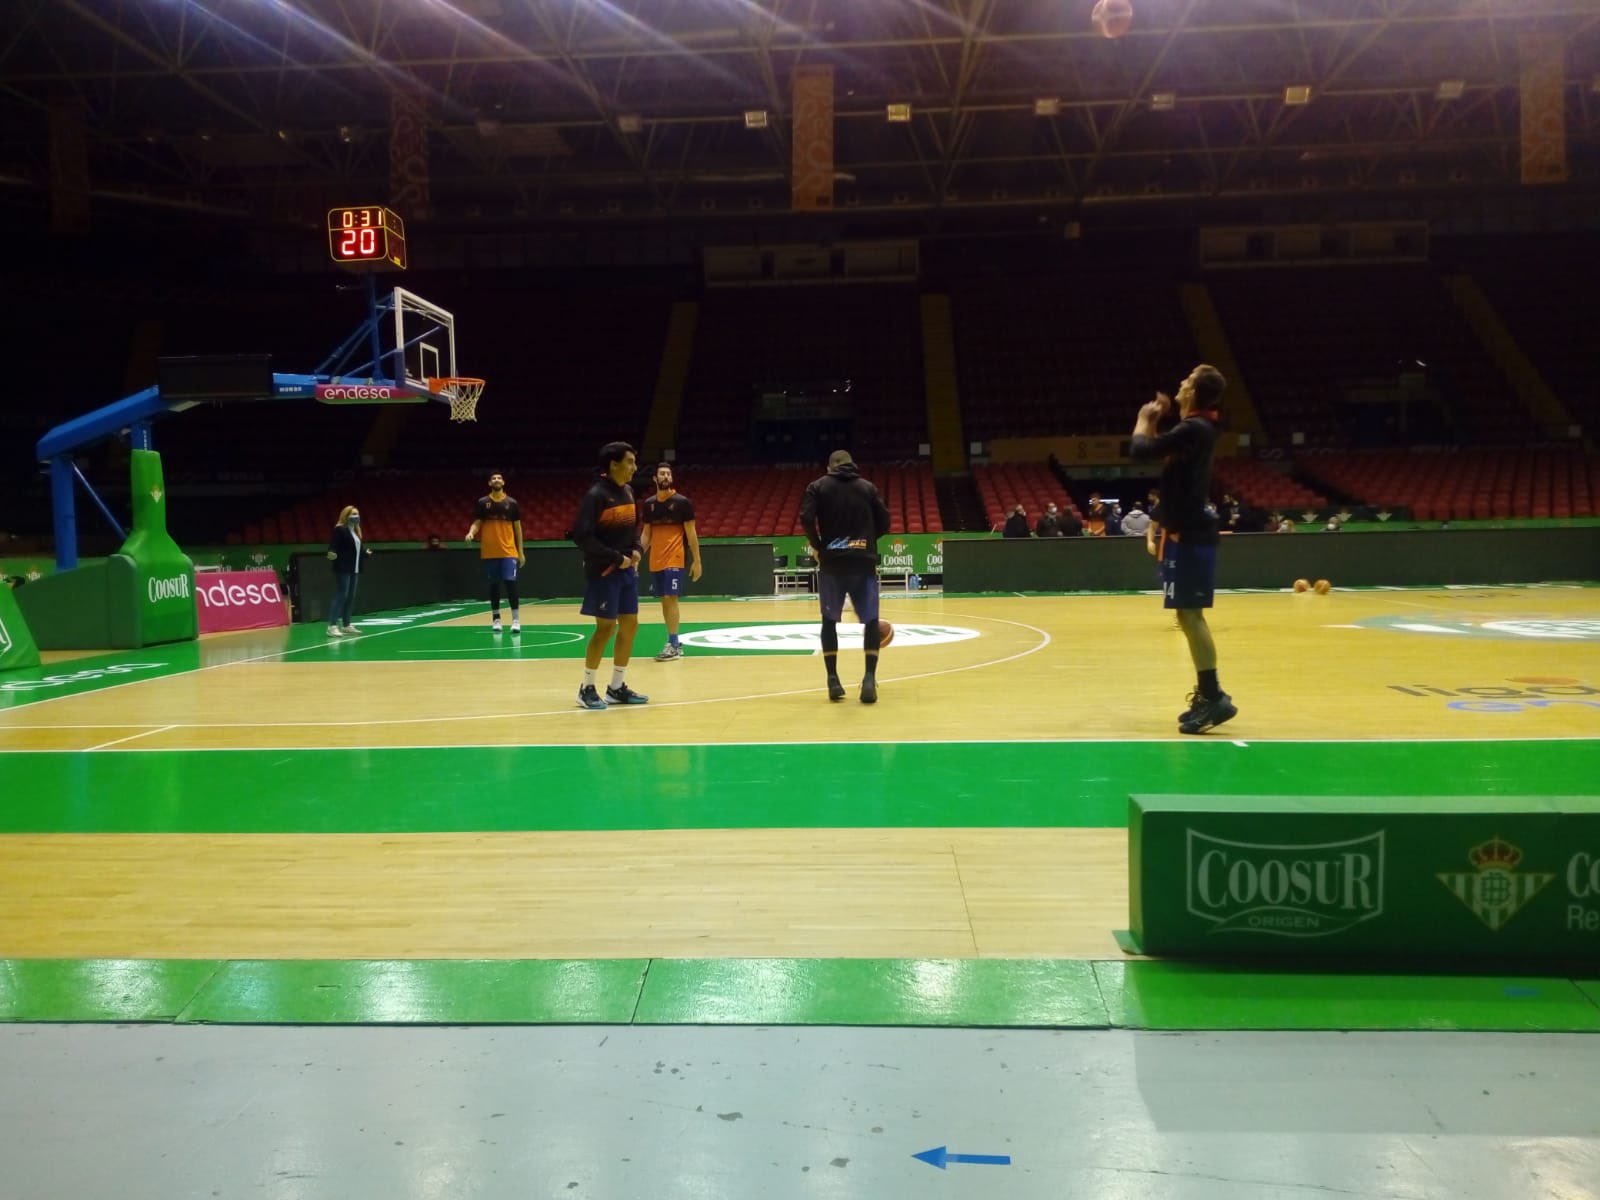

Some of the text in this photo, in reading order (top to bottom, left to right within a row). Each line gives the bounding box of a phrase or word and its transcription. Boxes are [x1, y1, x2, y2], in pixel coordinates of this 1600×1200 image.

[343, 210, 382, 227] 0:31
[342, 229, 375, 255] 20
[324, 386, 390, 399] endesa
[148, 573, 190, 603] COOSUR
[672, 578, 679, 590] 5
[1197, 849, 1375, 910] COOSUR
[1247, 915, 1320, 929] ORIGEN
